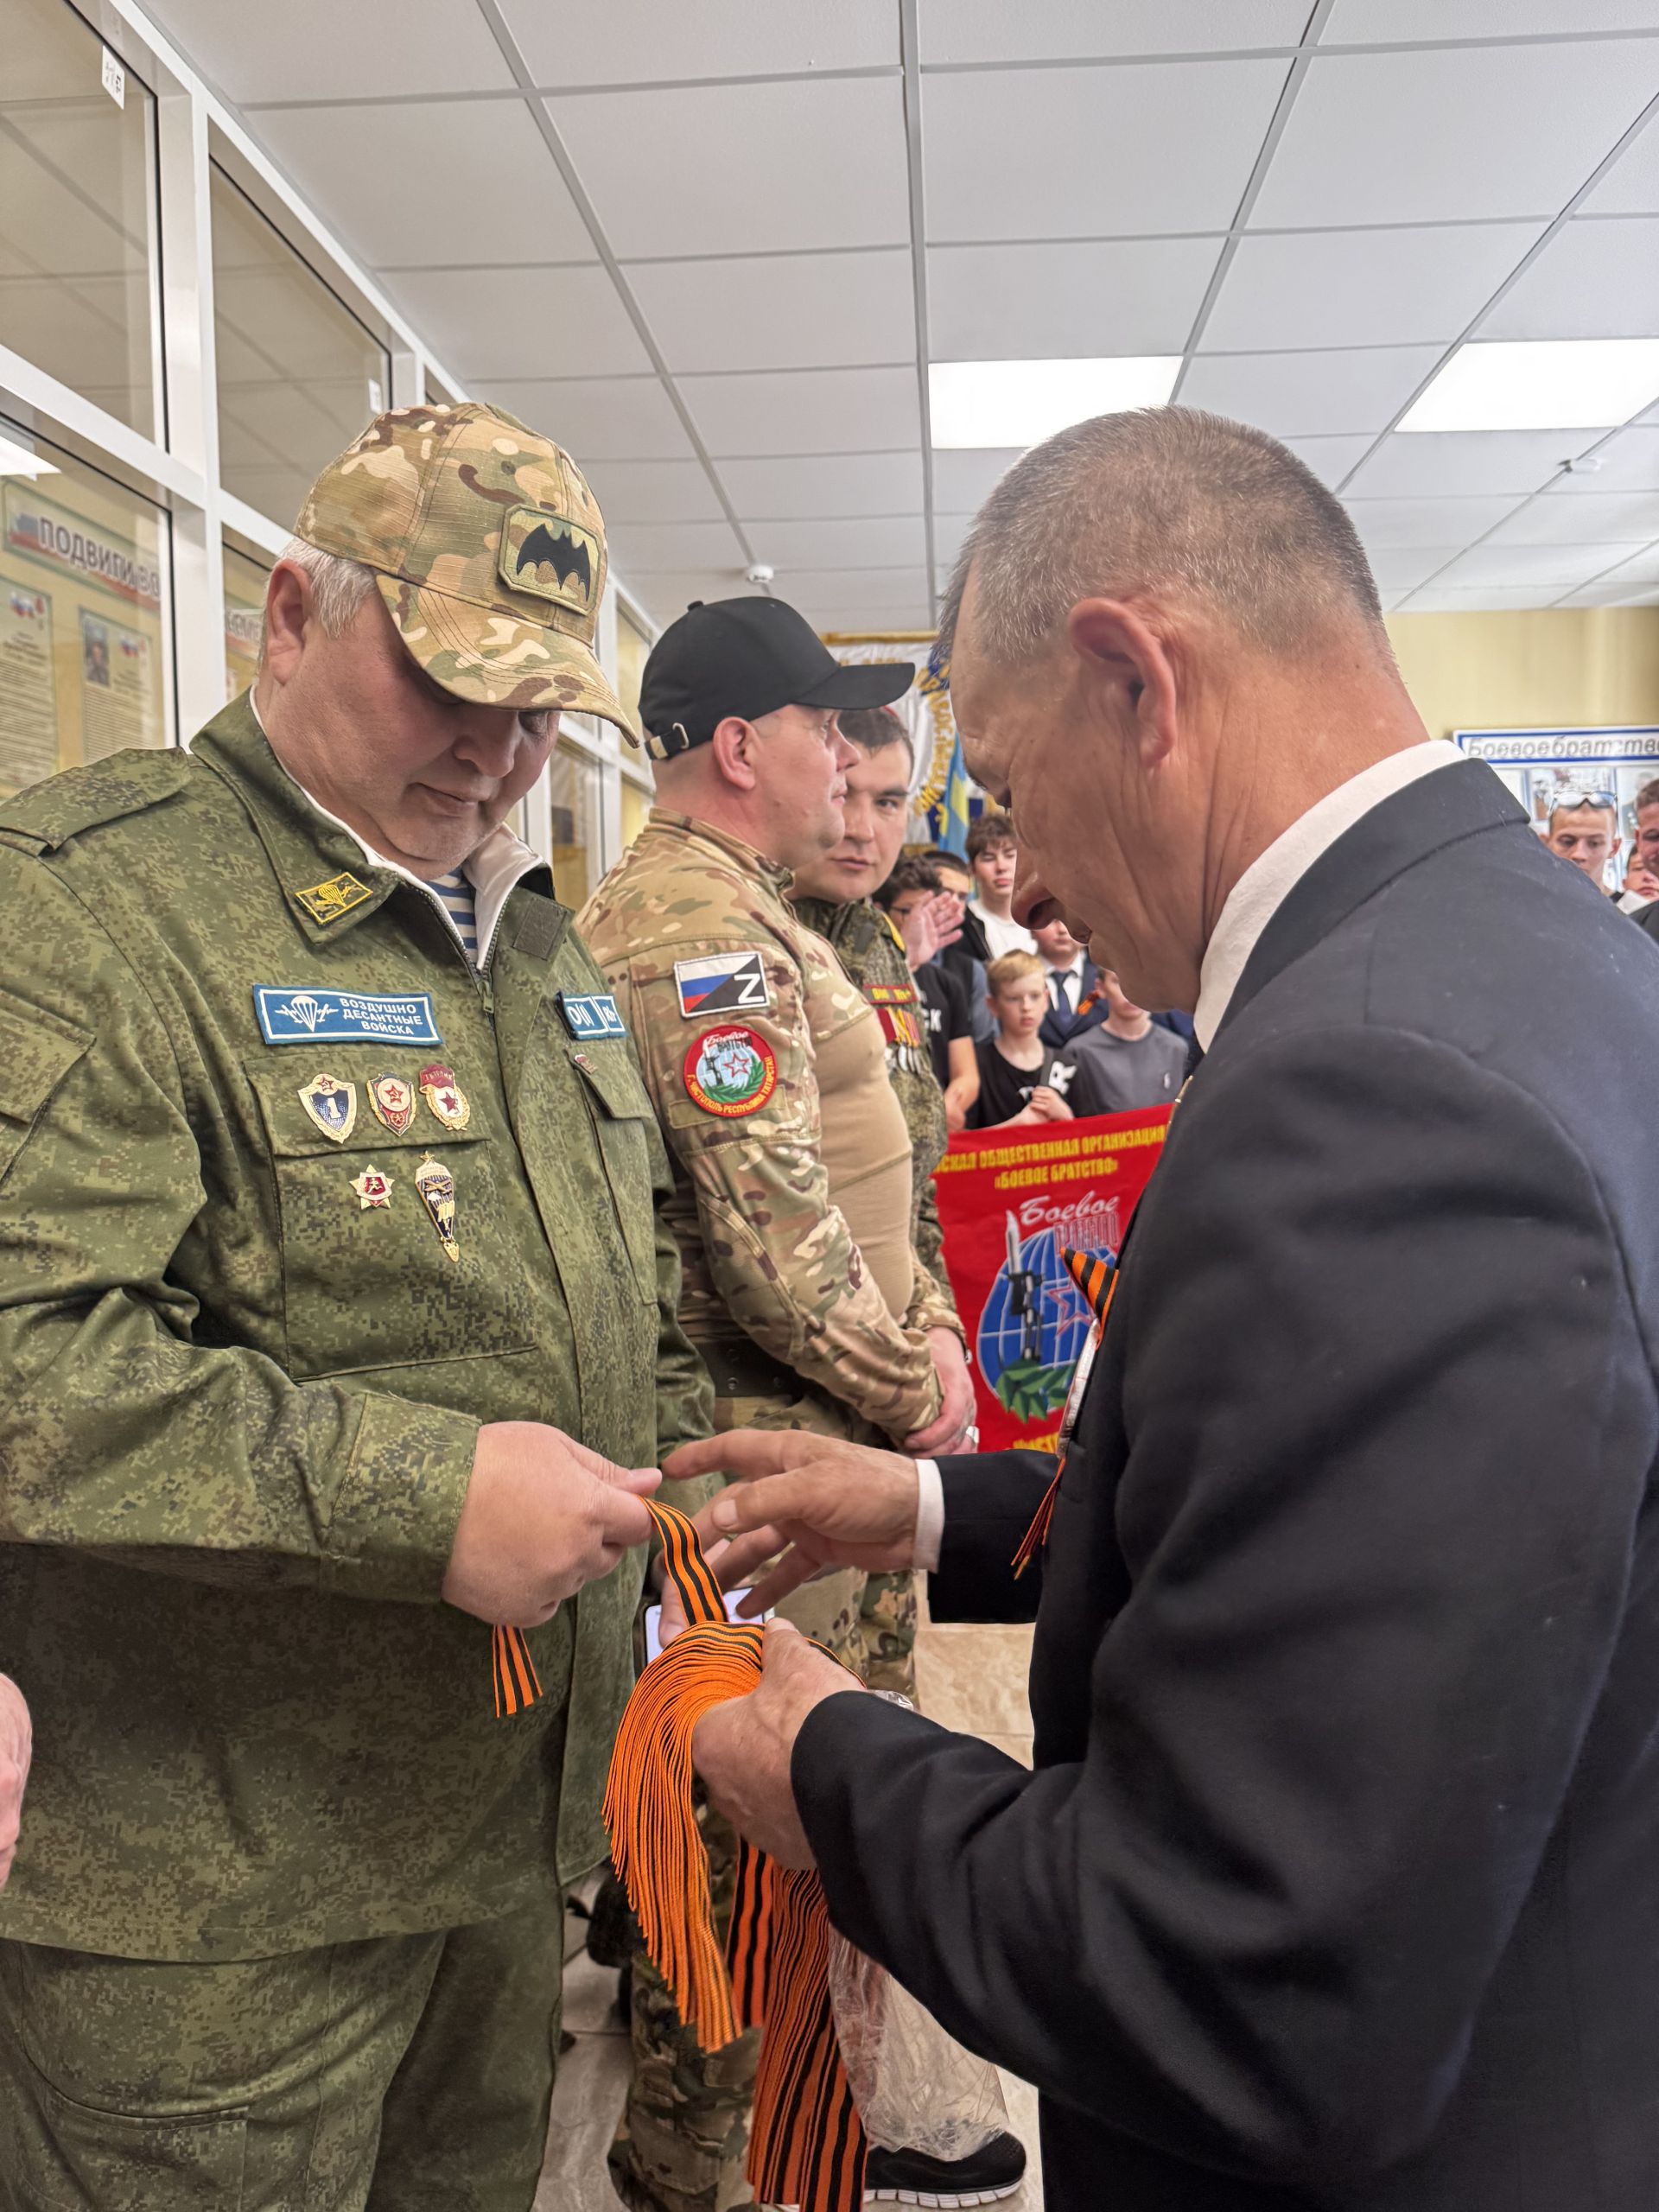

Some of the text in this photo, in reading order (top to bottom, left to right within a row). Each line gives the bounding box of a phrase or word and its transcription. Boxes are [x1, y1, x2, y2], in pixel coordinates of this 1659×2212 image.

[1468, 738, 1550, 758] Боевое
[734, 973, 765, 1004] Z
[339, 997, 416, 1015] ВОЗДУШНО
[342, 1008, 423, 1026] ДЕСАНТНЫЕ
[361, 1020, 414, 1035] ВОЙСКА
[723, 1093, 766, 1113] РЕСПУБЛИКА
[1020, 1190, 1120, 1226] Боевое
